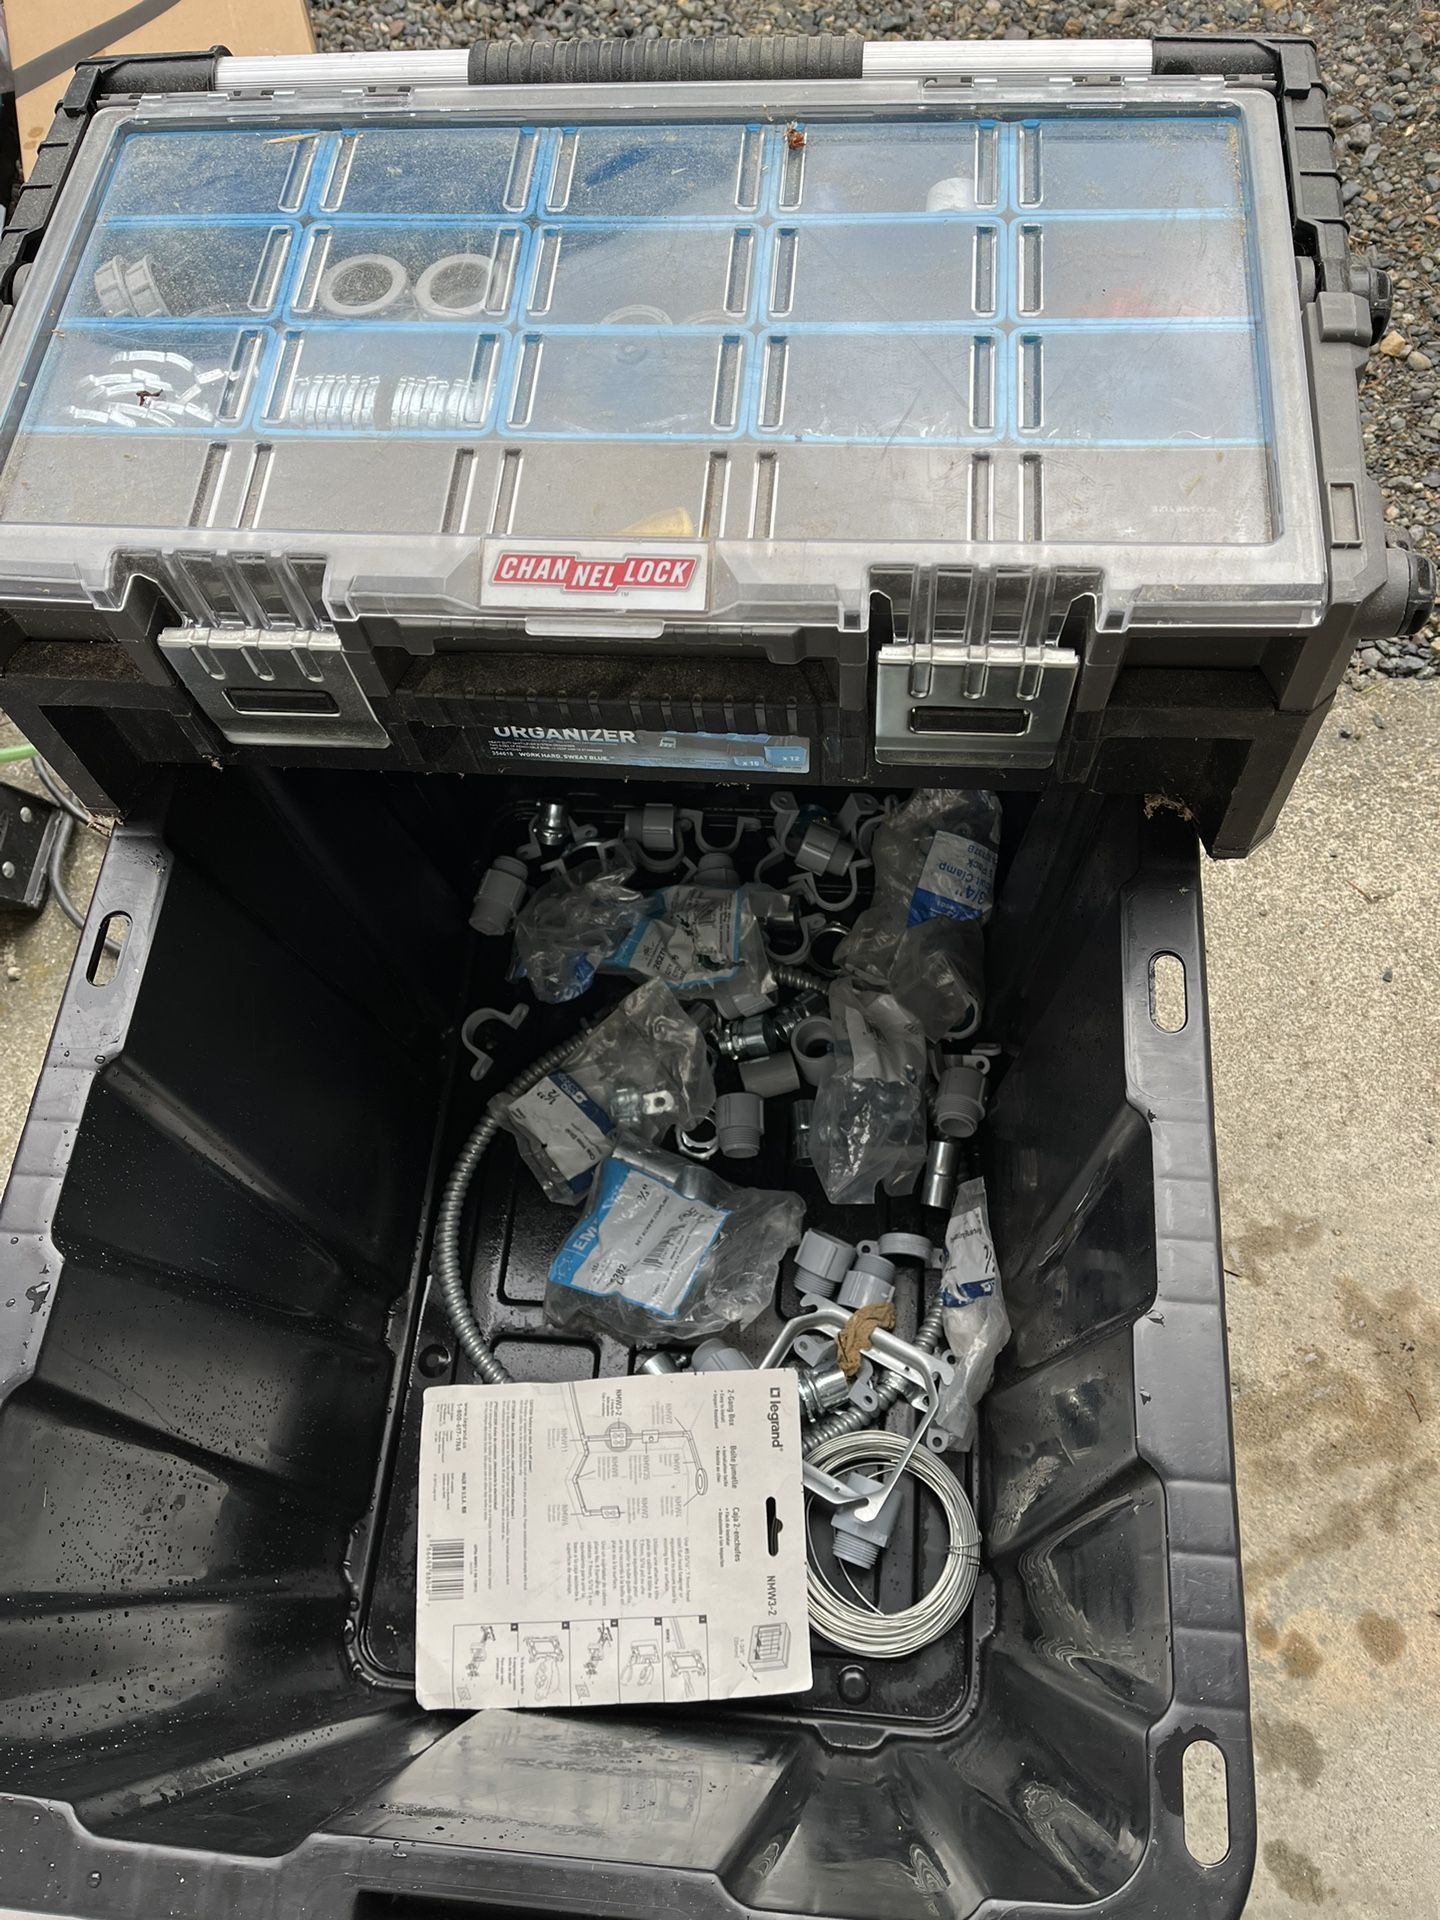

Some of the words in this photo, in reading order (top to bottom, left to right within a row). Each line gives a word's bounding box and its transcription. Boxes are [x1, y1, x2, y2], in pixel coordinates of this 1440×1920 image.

[938, 862, 974, 882] Clamp
[767, 1401, 783, 1448] legrand
[733, 1523, 741, 1562] 2-enchufes
[766, 1575, 777, 1616] NMW3-2
